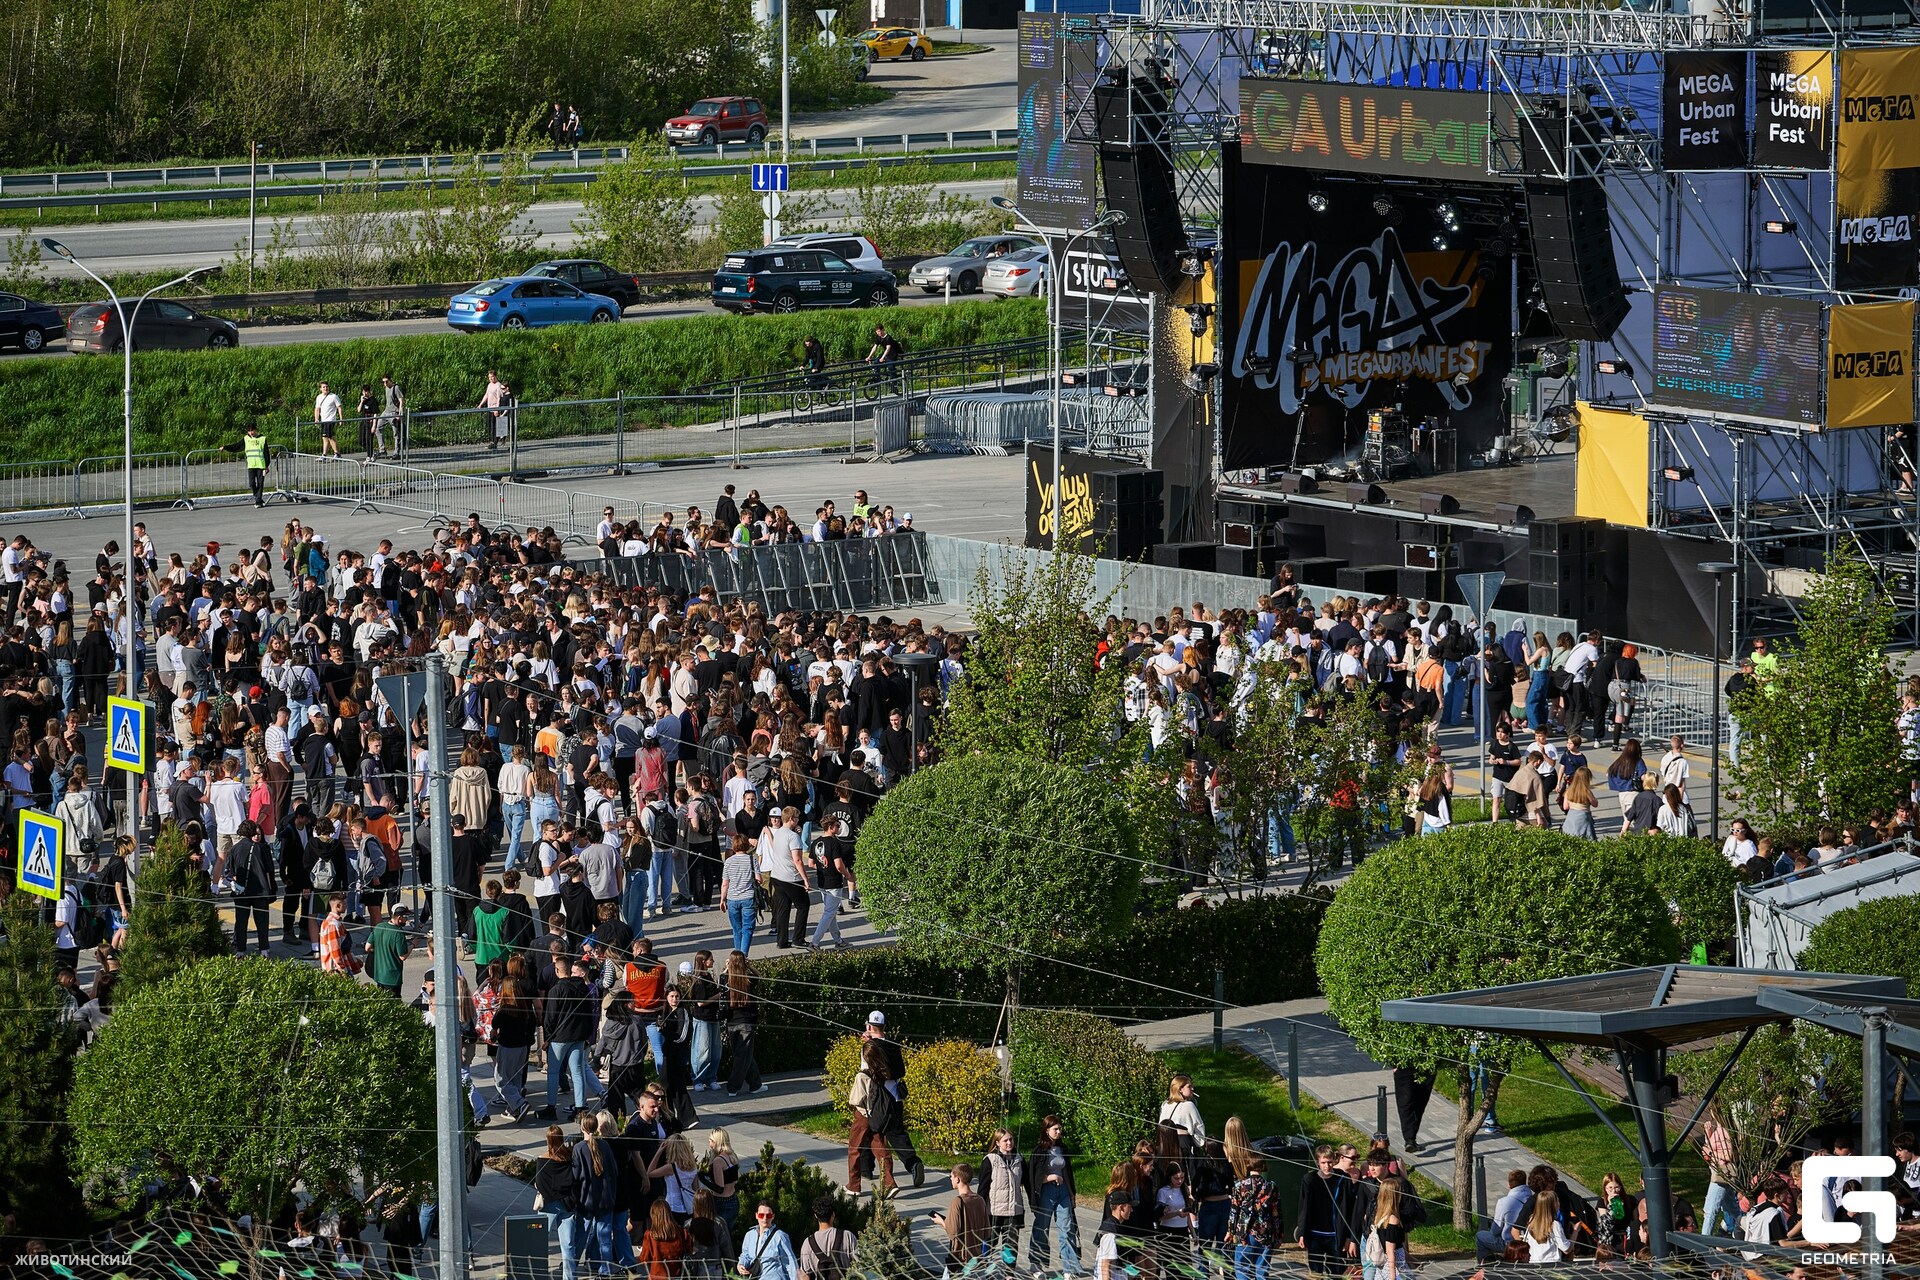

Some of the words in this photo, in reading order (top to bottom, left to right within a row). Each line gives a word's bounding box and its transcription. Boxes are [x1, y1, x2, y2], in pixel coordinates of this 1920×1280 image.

[1679, 73, 1734, 96] MEGA
[1770, 72, 1821, 94] MEGA
[1679, 100, 1736, 121] Urban
[1770, 98, 1822, 120] Urban
[1679, 127, 1720, 147] Fest
[1769, 123, 1805, 144] Fest
